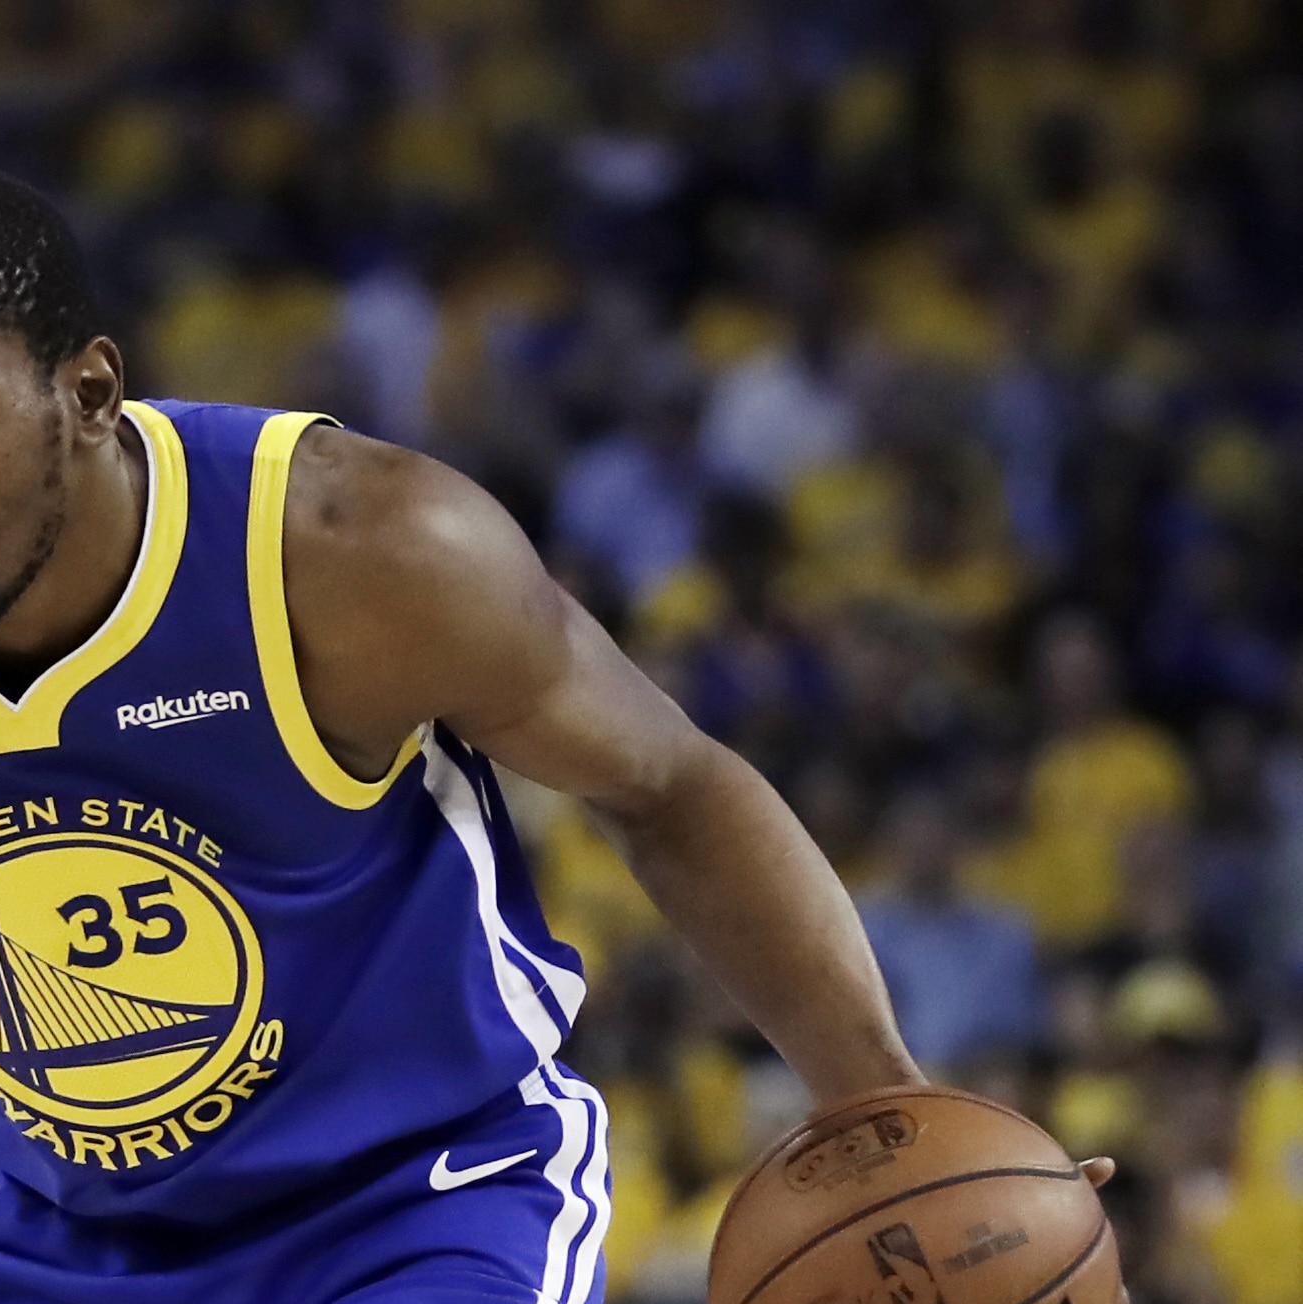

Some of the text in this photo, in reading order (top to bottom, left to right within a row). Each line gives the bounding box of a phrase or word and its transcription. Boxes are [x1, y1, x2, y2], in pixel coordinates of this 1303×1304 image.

[116, 689, 251, 731] Rakuten
[81, 798, 223, 869] STATE
[56, 874, 189, 969] 35
